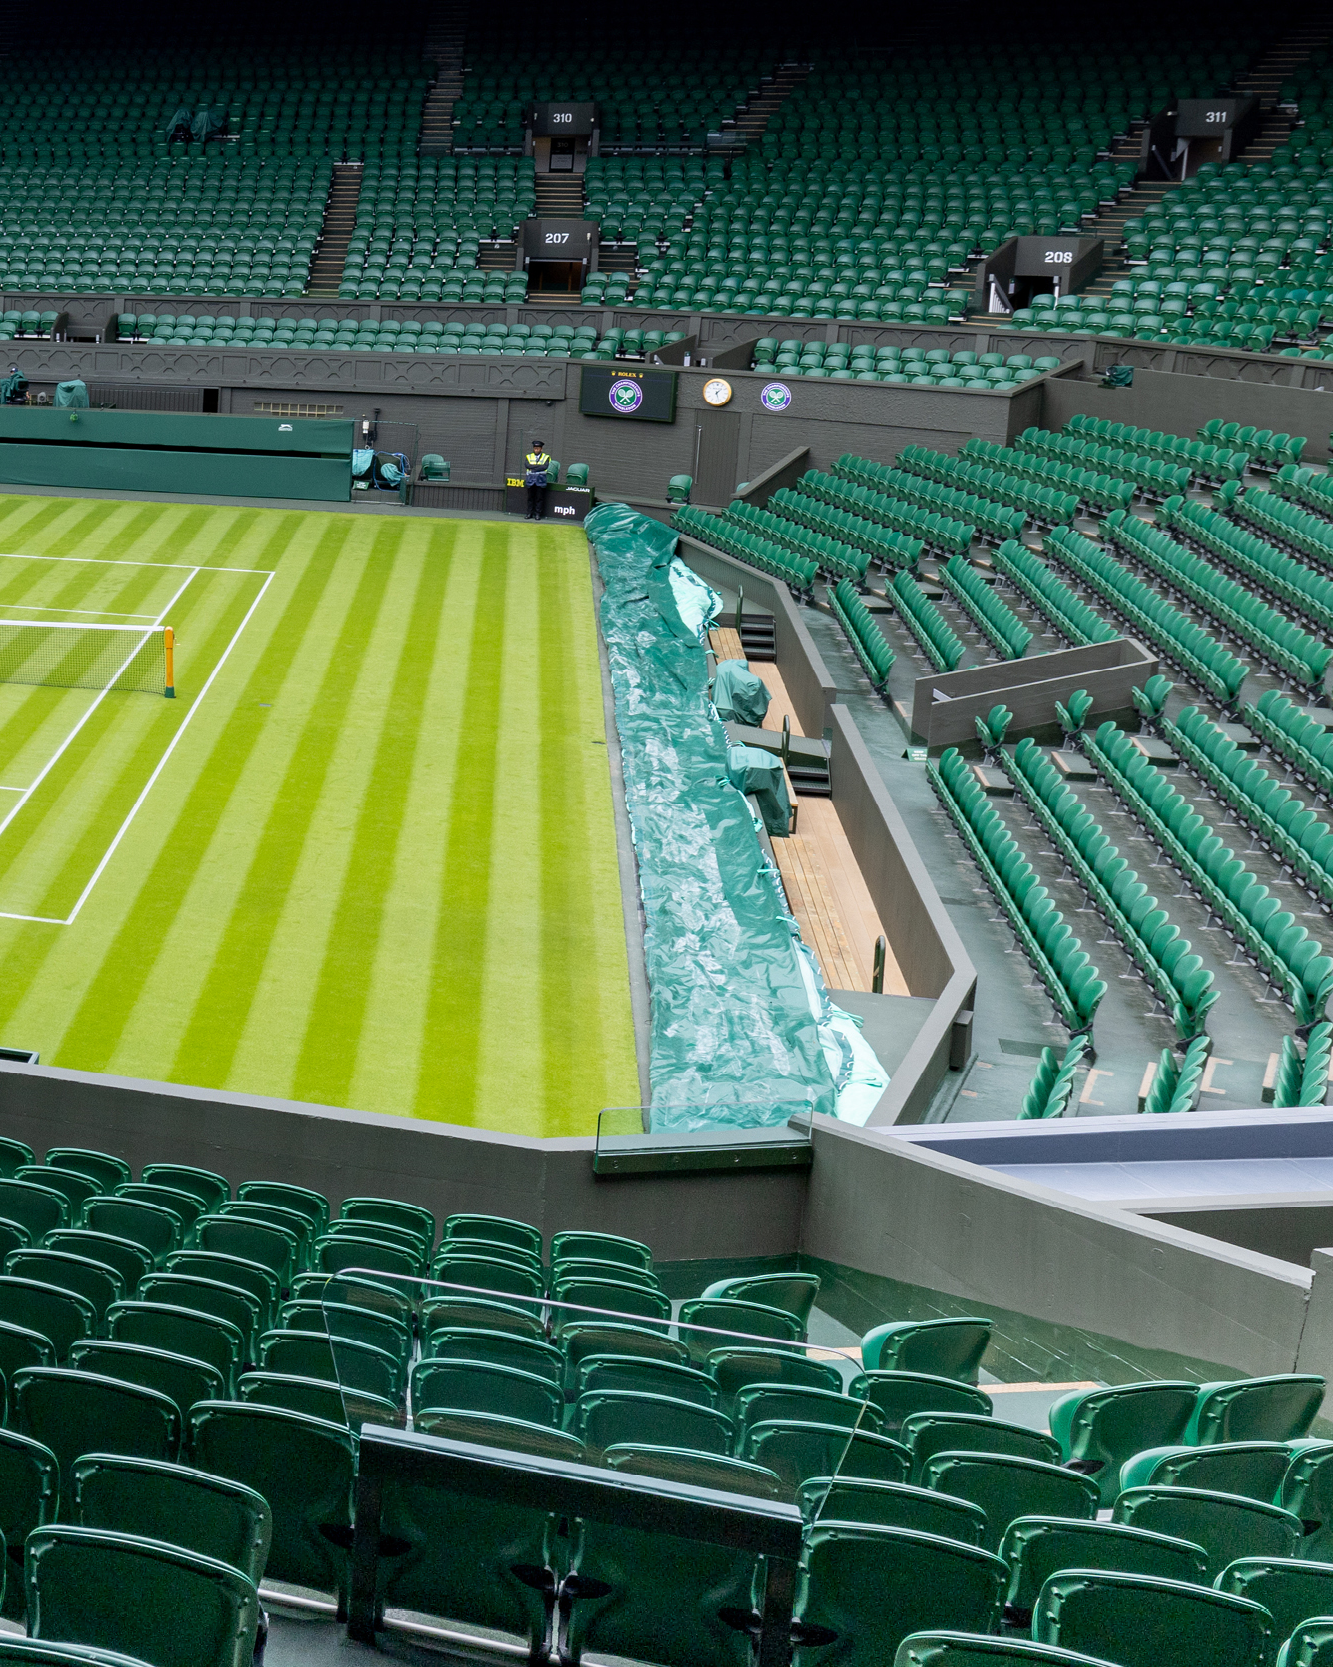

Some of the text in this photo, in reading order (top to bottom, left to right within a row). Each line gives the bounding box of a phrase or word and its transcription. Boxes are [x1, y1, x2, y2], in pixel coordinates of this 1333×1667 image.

[553, 113, 572, 123] 310
[1205, 111, 1227, 123] 311
[545, 233, 570, 244] 207
[1044, 251, 1073, 264] 208
[507, 478, 525, 488] IBM
[554, 506, 576, 515] mph
